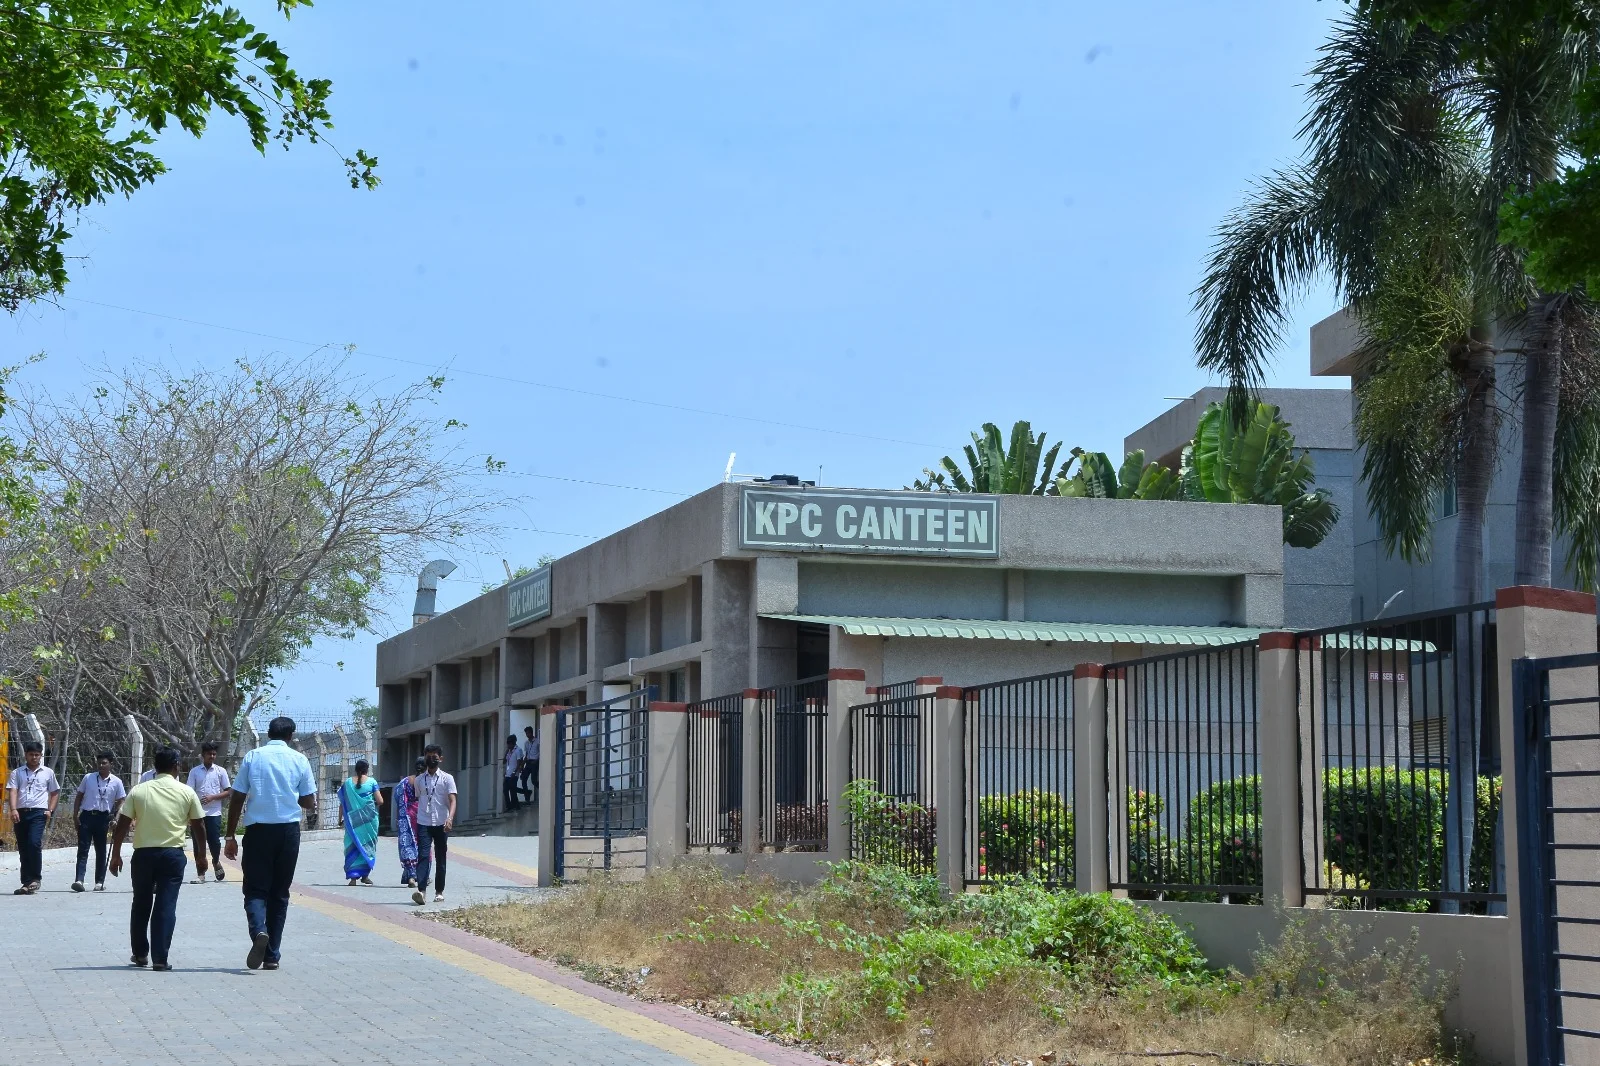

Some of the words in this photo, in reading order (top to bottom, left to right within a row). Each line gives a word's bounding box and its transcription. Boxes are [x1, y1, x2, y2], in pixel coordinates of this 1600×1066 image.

[755, 501, 822, 538] KPC
[836, 504, 988, 544] CANTEEN
[510, 590, 521, 618] KPC
[522, 577, 548, 613] CANTEEN
[1382, 673, 1405, 681] SERCE
